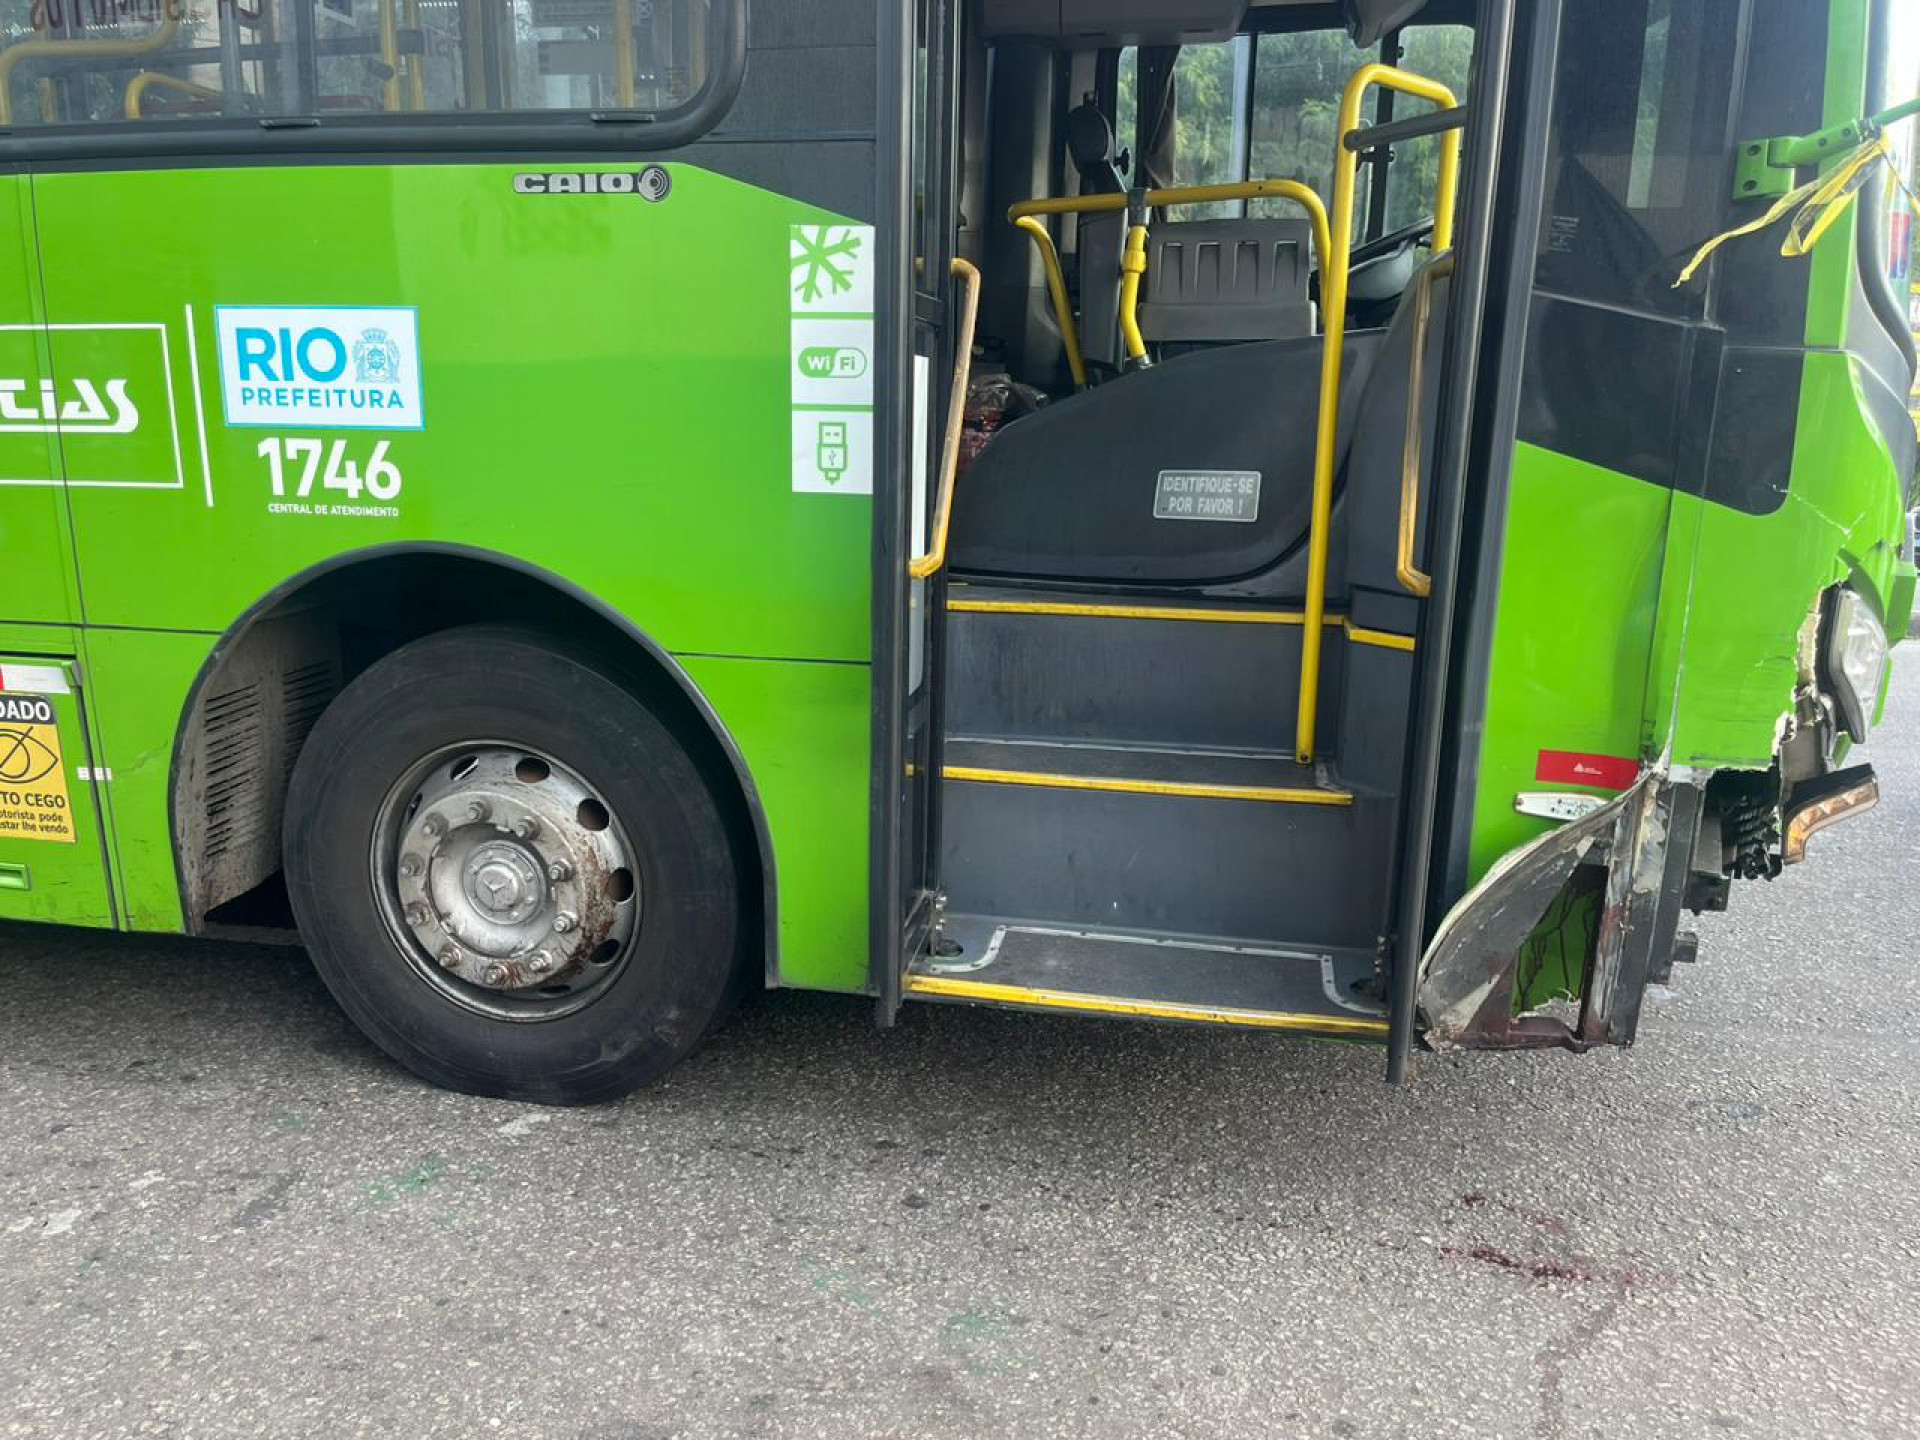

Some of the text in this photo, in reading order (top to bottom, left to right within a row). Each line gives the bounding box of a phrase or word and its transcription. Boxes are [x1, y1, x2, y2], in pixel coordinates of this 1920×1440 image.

[513, 172, 635, 194] CAIO
[235, 326, 348, 382] RIO
[241, 386, 405, 409] PREFEITURA
[257, 436, 402, 500] 1746
[268, 503, 400, 517] CENTRAL DE ATENDIMENTO
[1169, 497, 1193, 513] POR
[1197, 497, 1235, 514] FAVOR
[25, 793, 66, 809] CEGO
[39, 812, 64, 823] pode
[39, 824, 69, 835] vendo
